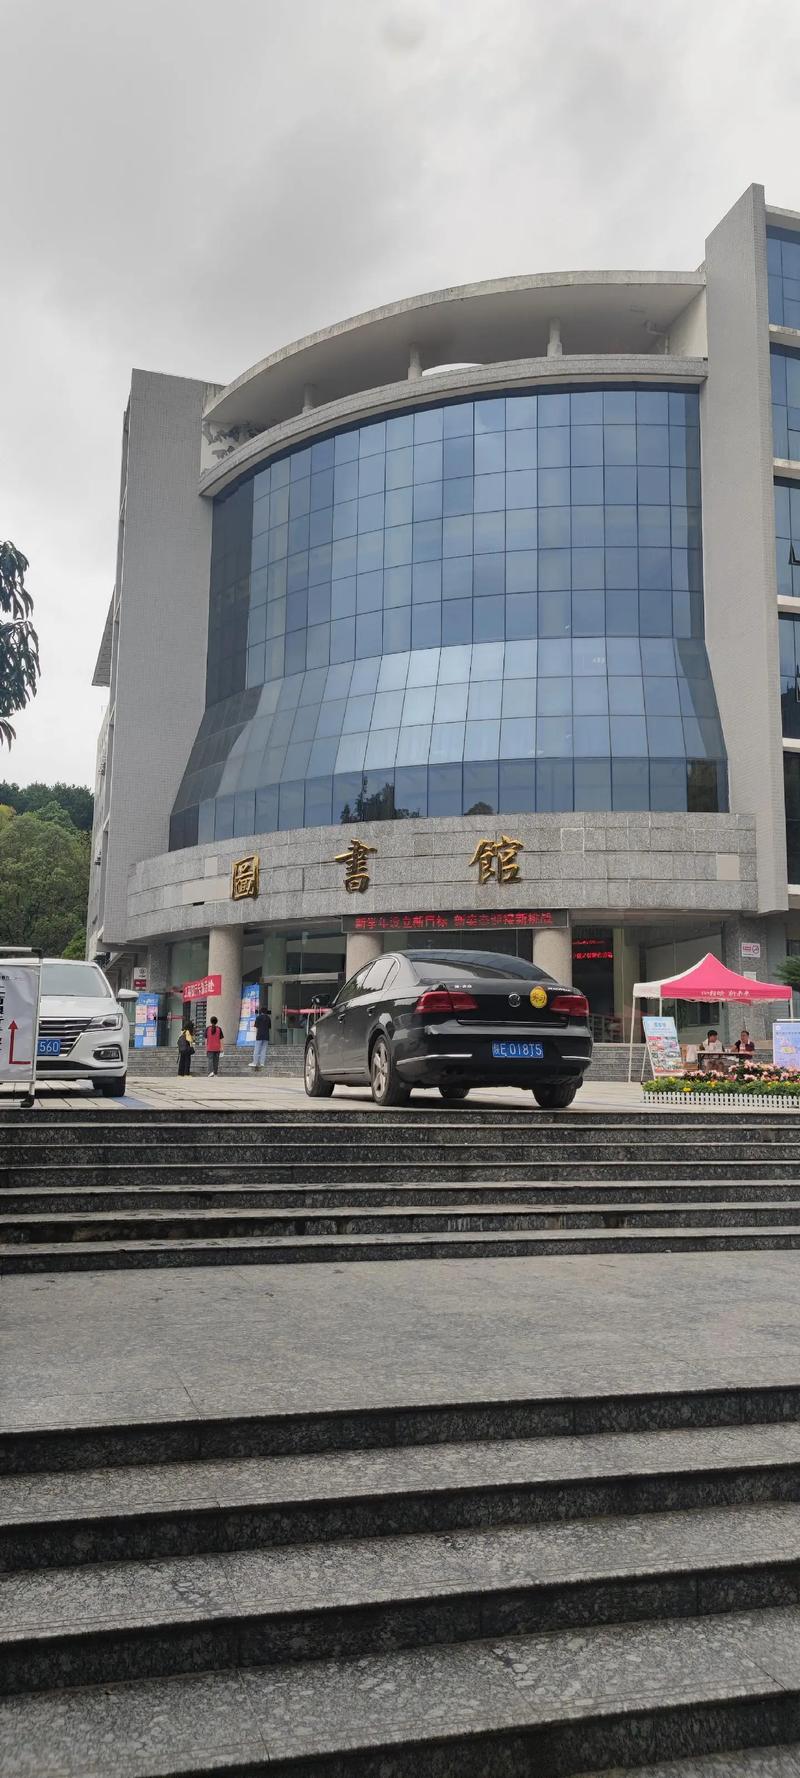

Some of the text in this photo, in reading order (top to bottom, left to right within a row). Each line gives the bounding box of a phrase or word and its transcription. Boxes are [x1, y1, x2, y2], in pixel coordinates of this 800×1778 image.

[231, 835, 524, 901] 圖書館
[39, 1041, 59, 1053] 560
